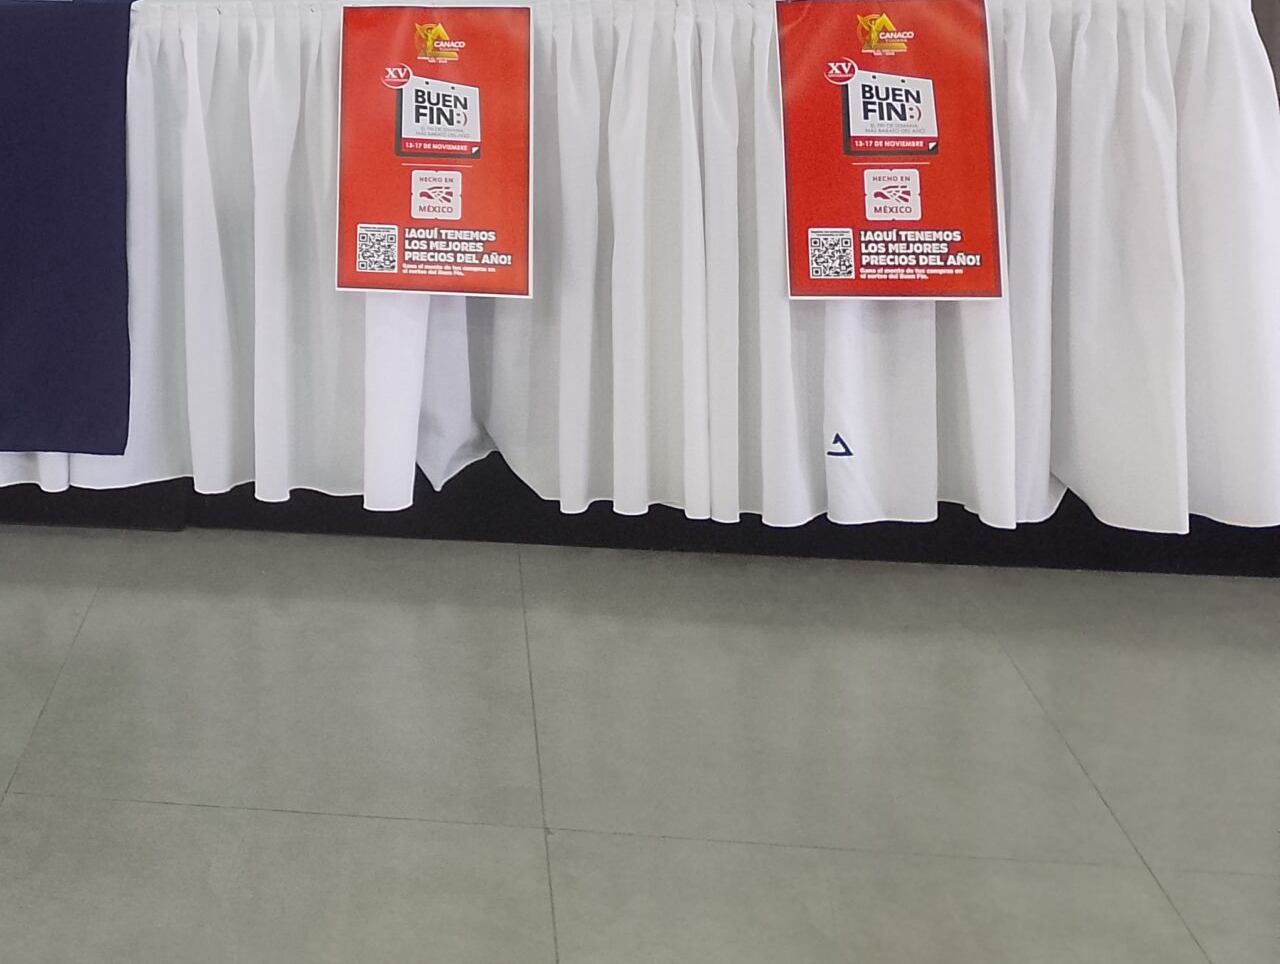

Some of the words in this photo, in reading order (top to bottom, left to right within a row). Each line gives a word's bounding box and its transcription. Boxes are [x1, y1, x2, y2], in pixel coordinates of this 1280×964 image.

[879, 31, 914, 39] CANACO
[385, 67, 408, 79] XV
[827, 62, 852, 74] XV
[414, 88, 468, 110] BUEN
[861, 83, 921, 104] BUEN
[432, 143, 468, 151] NOVIEMBRE
[418, 204, 454, 214] MÉXICO
[874, 204, 912, 214] MÉXICO
[404, 227, 438, 239] ¡AQUÍ
[440, 229, 497, 242] TENEMOS
[860, 229, 898, 241] ¡AQUÍ
[899, 230, 962, 241] TENEMOS
[404, 239, 428, 250] LOS
[429, 241, 484, 253] MEJORES
[861, 242, 886, 253] LOS
[888, 242, 949, 253] MEJORES
[404, 251, 455, 263] PRECIOS
[456, 253, 480, 264] DEL
[481, 252, 512, 265] AÑO!
[862, 254, 917, 266] PRECIOS
[919, 254, 944, 265] DEL
[946, 252, 981, 266] AÑO!
